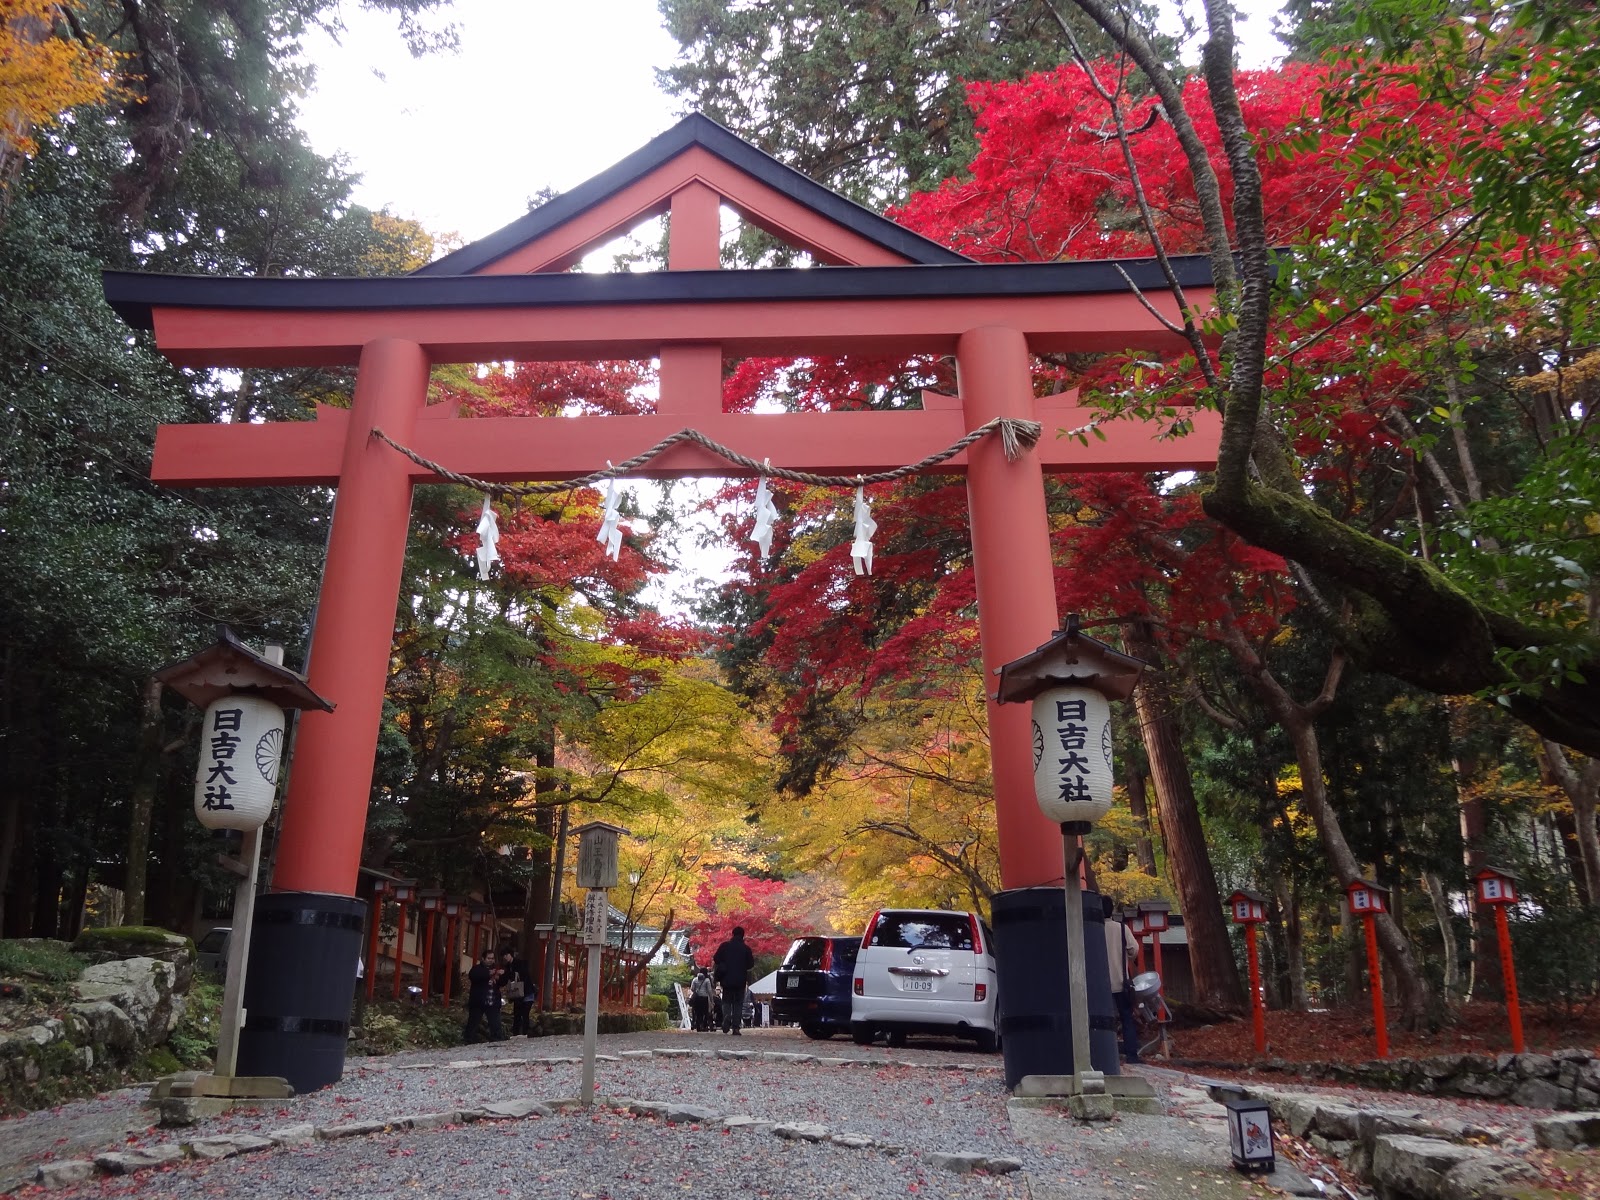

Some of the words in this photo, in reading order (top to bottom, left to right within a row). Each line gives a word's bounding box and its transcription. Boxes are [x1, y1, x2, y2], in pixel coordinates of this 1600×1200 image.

[202, 708, 243, 811] 日吉大社
[1056, 700, 1092, 803] 日吉大社
[910, 981, 932, 990] 10-09
